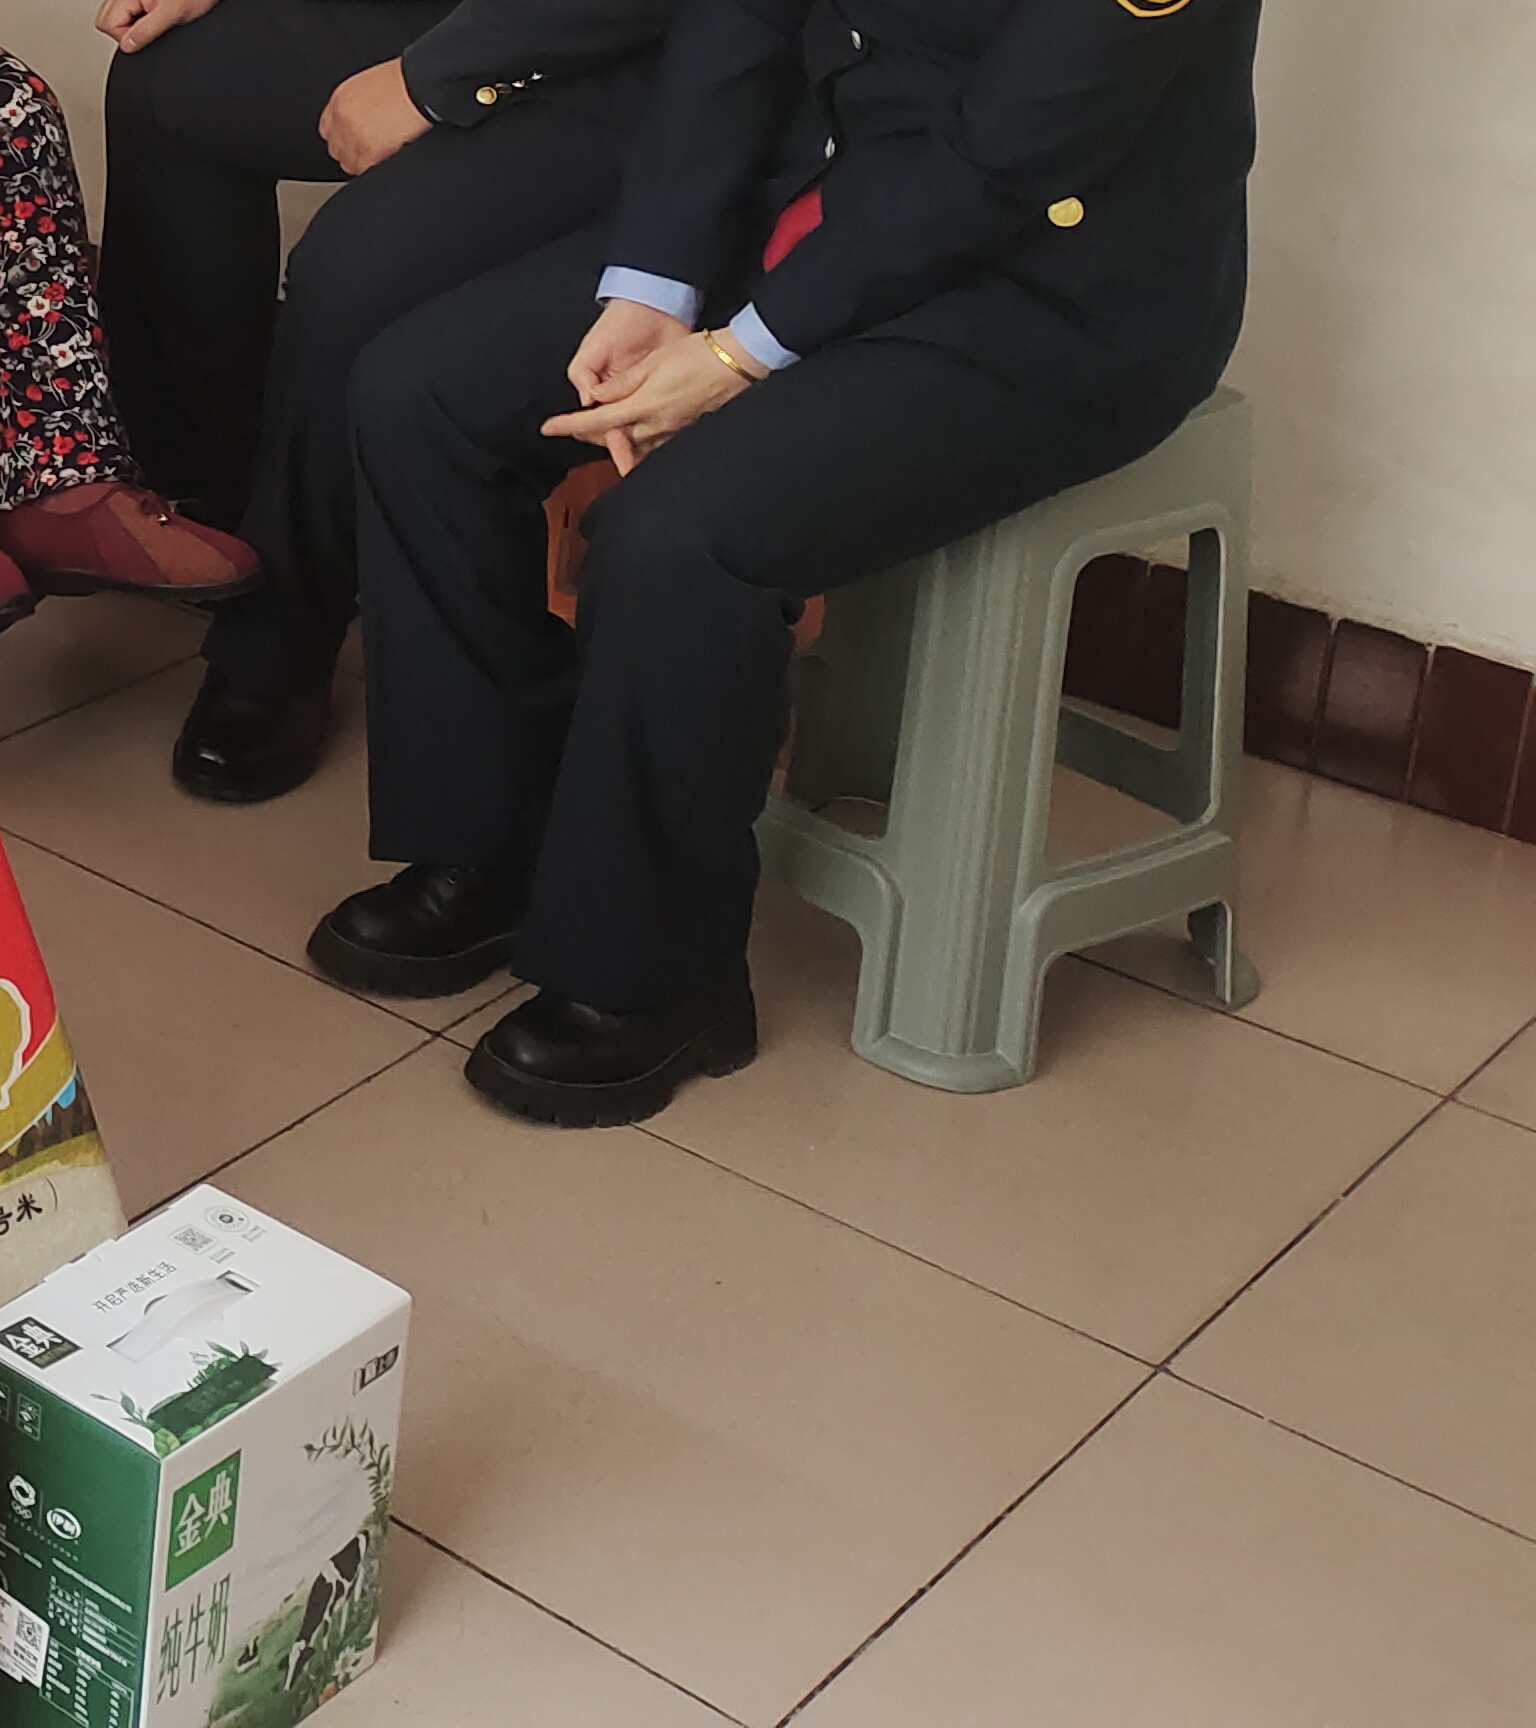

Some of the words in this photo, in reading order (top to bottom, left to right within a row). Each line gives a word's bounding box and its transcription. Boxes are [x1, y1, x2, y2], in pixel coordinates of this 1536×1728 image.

[174, 1470, 233, 1558] 金典
[155, 1572, 232, 1706] 纯牛奶
